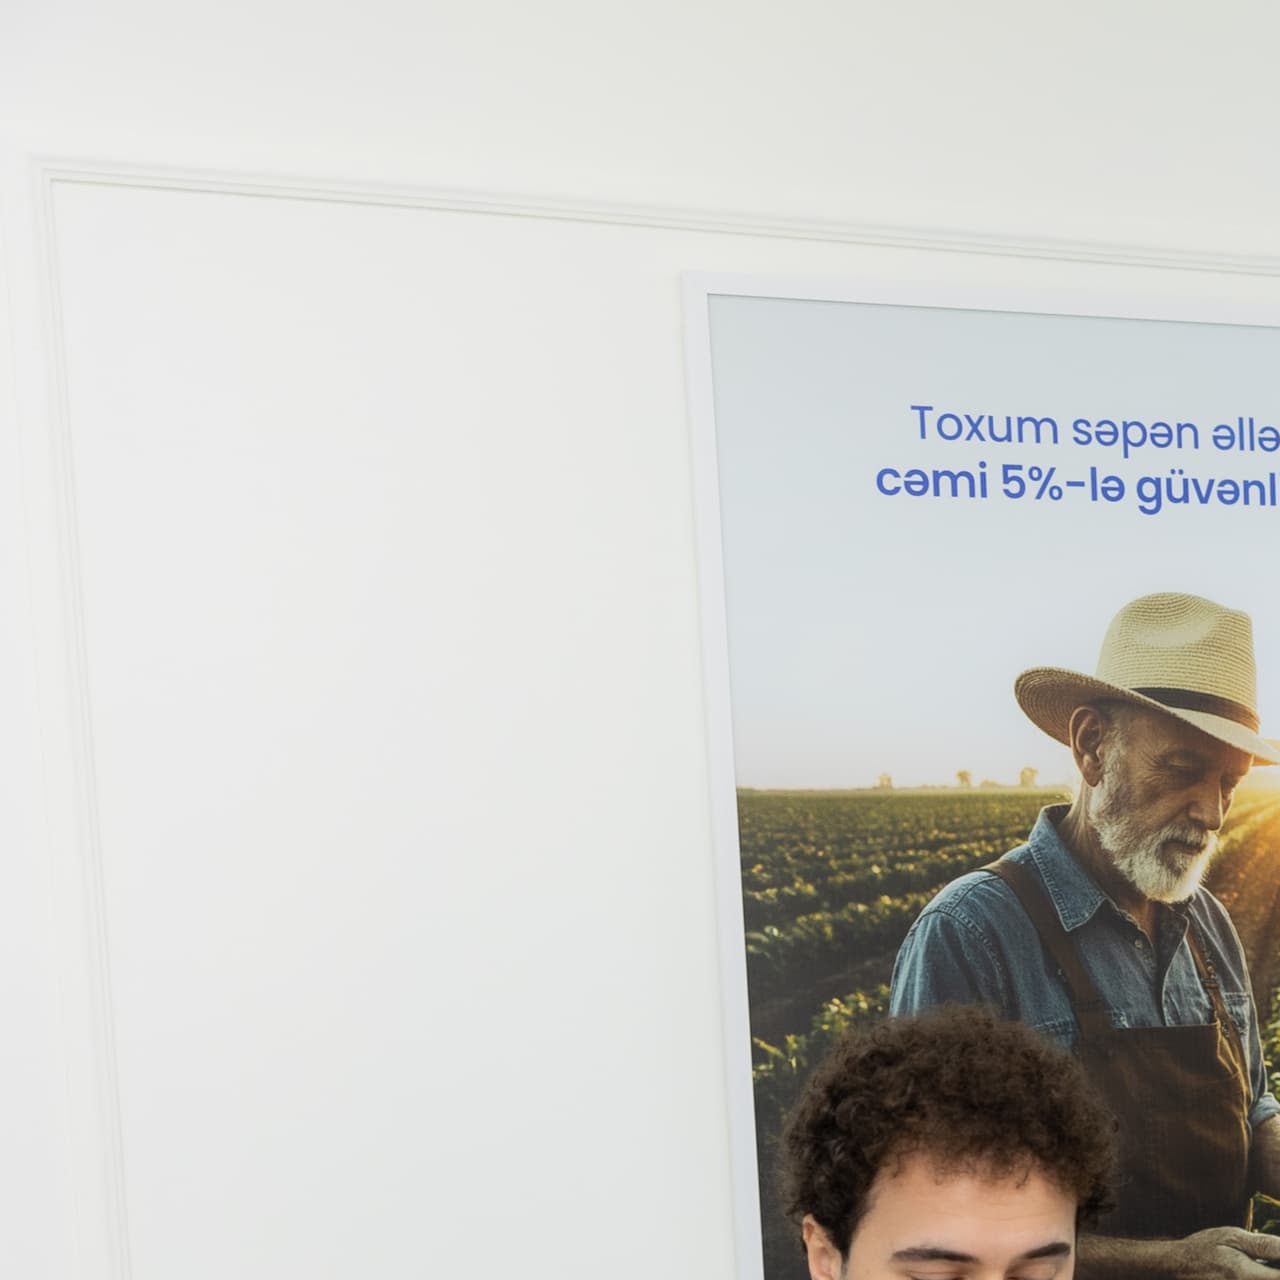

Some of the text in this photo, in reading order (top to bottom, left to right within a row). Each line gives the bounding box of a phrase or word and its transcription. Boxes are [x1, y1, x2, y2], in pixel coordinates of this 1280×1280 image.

[911, 404, 1058, 445] Toxum
[1072, 416, 1200, 458] səpən
[876, 460, 988, 499] cəmi
[1001, 463, 1126, 502] 5%-lə
